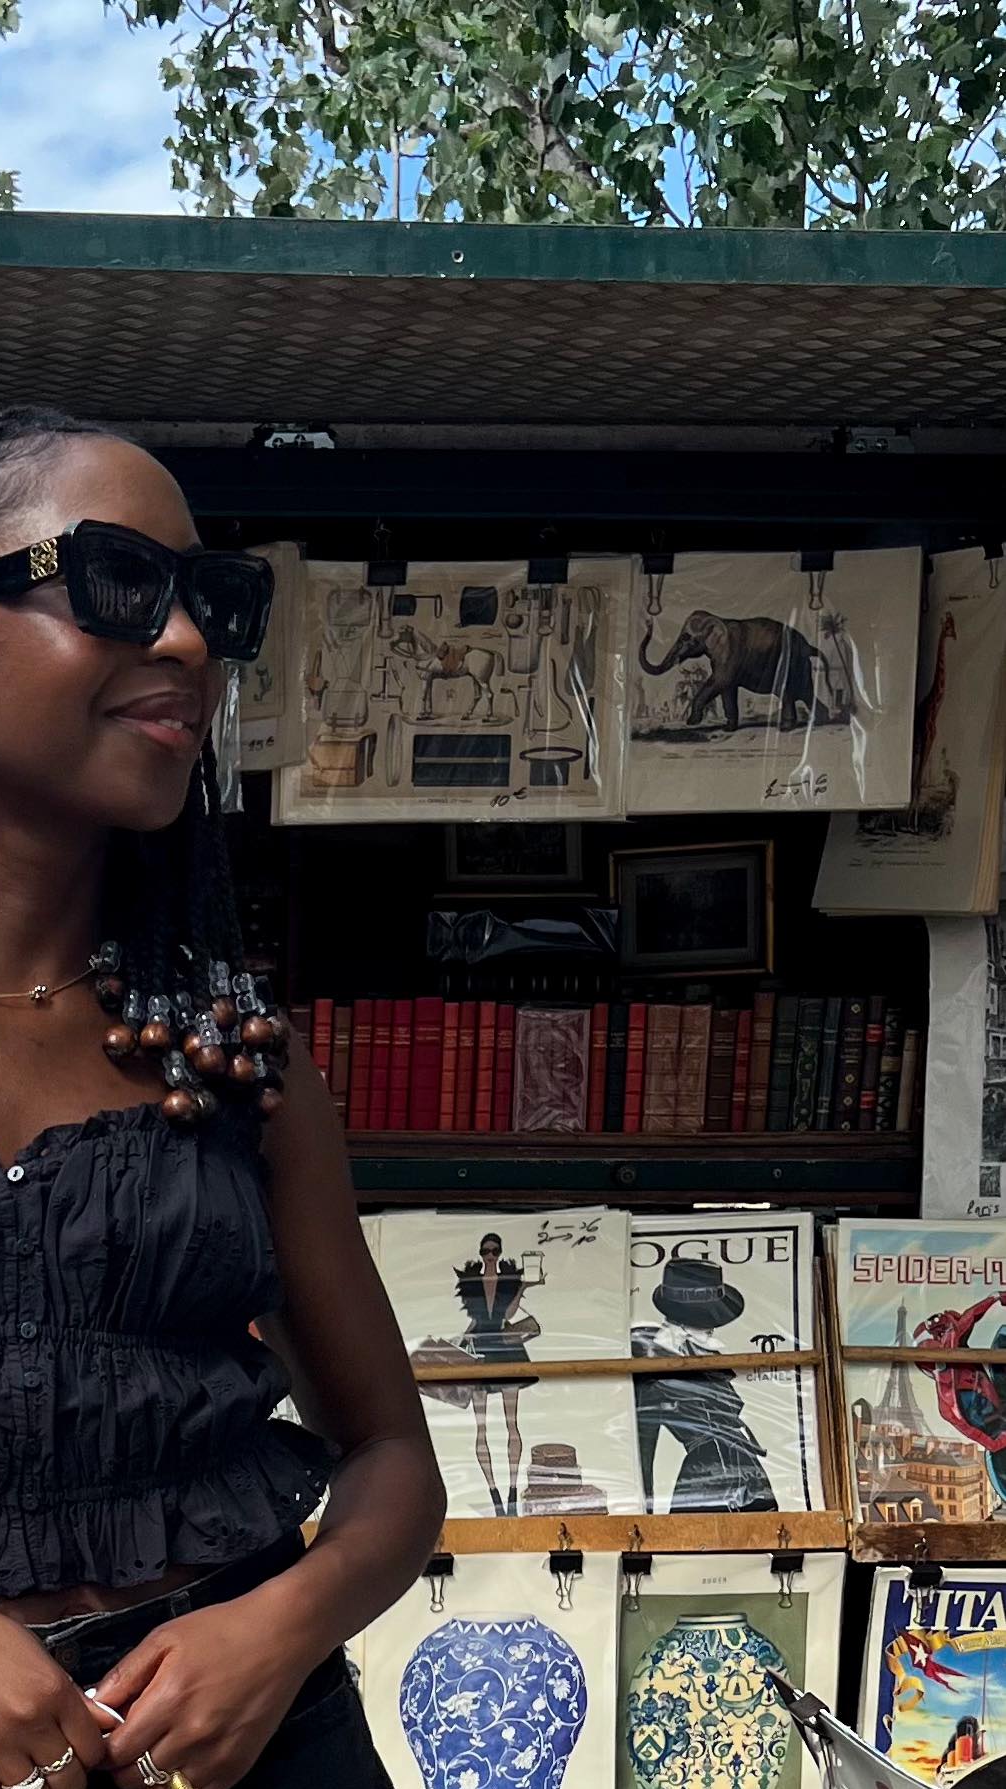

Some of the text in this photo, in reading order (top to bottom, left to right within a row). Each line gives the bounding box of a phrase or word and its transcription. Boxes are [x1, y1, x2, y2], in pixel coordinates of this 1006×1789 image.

[490, 787, 528, 808] 10€
[541, 1217, 602, 1233] 1 6
[571, 1235, 597, 1249] 10
